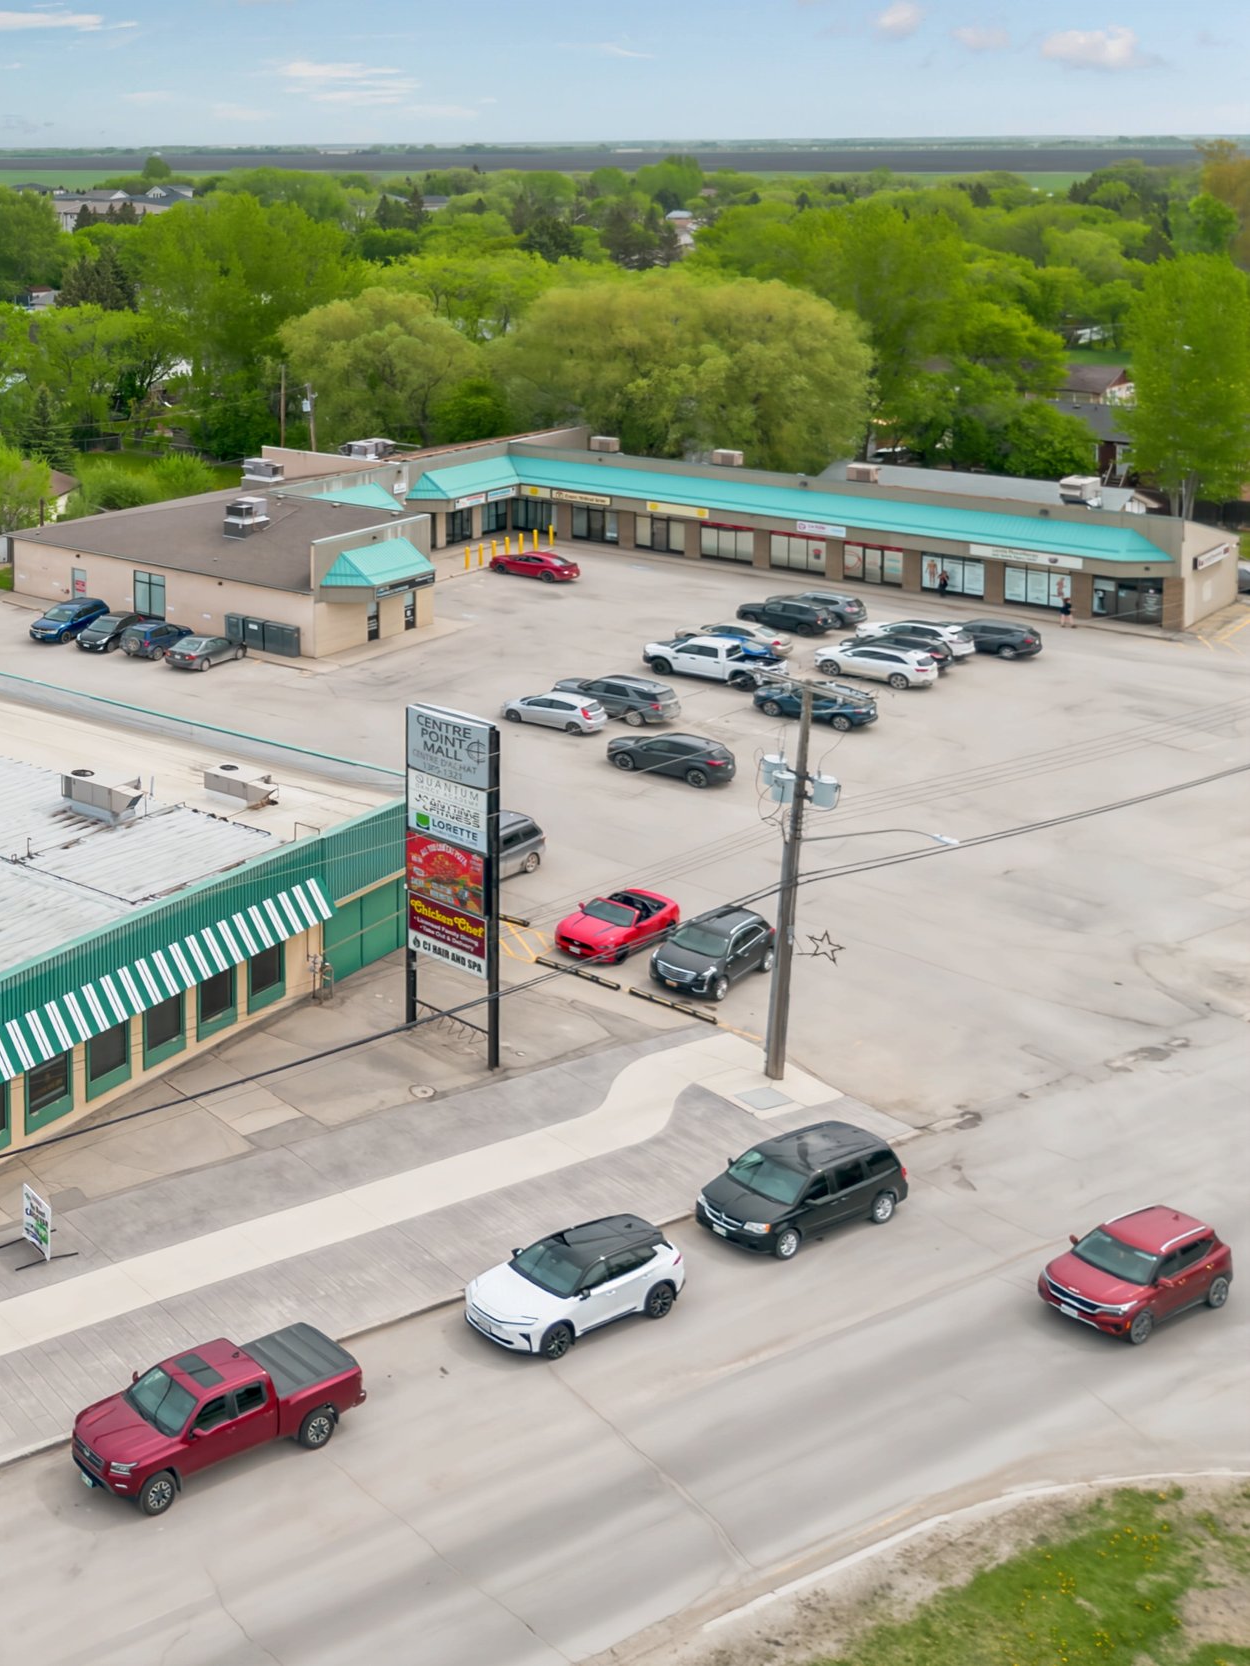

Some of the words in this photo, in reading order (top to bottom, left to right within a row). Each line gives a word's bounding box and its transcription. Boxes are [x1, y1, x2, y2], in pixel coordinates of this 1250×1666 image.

[417, 715, 472, 739] CENTRE
[420, 727, 466, 749] POINT
[423, 741, 463, 762] MALL
[415, 774, 479, 801] QUANTUM
[432, 819, 478, 842] LORETTE
[410, 899, 454, 927] Chicken
[454, 916, 485, 938] Chef
[422, 940, 431, 951] CJ
[432, 944, 450, 960] HAIR
[451, 952, 466, 966] AND
[467, 959, 482, 973] SPA
